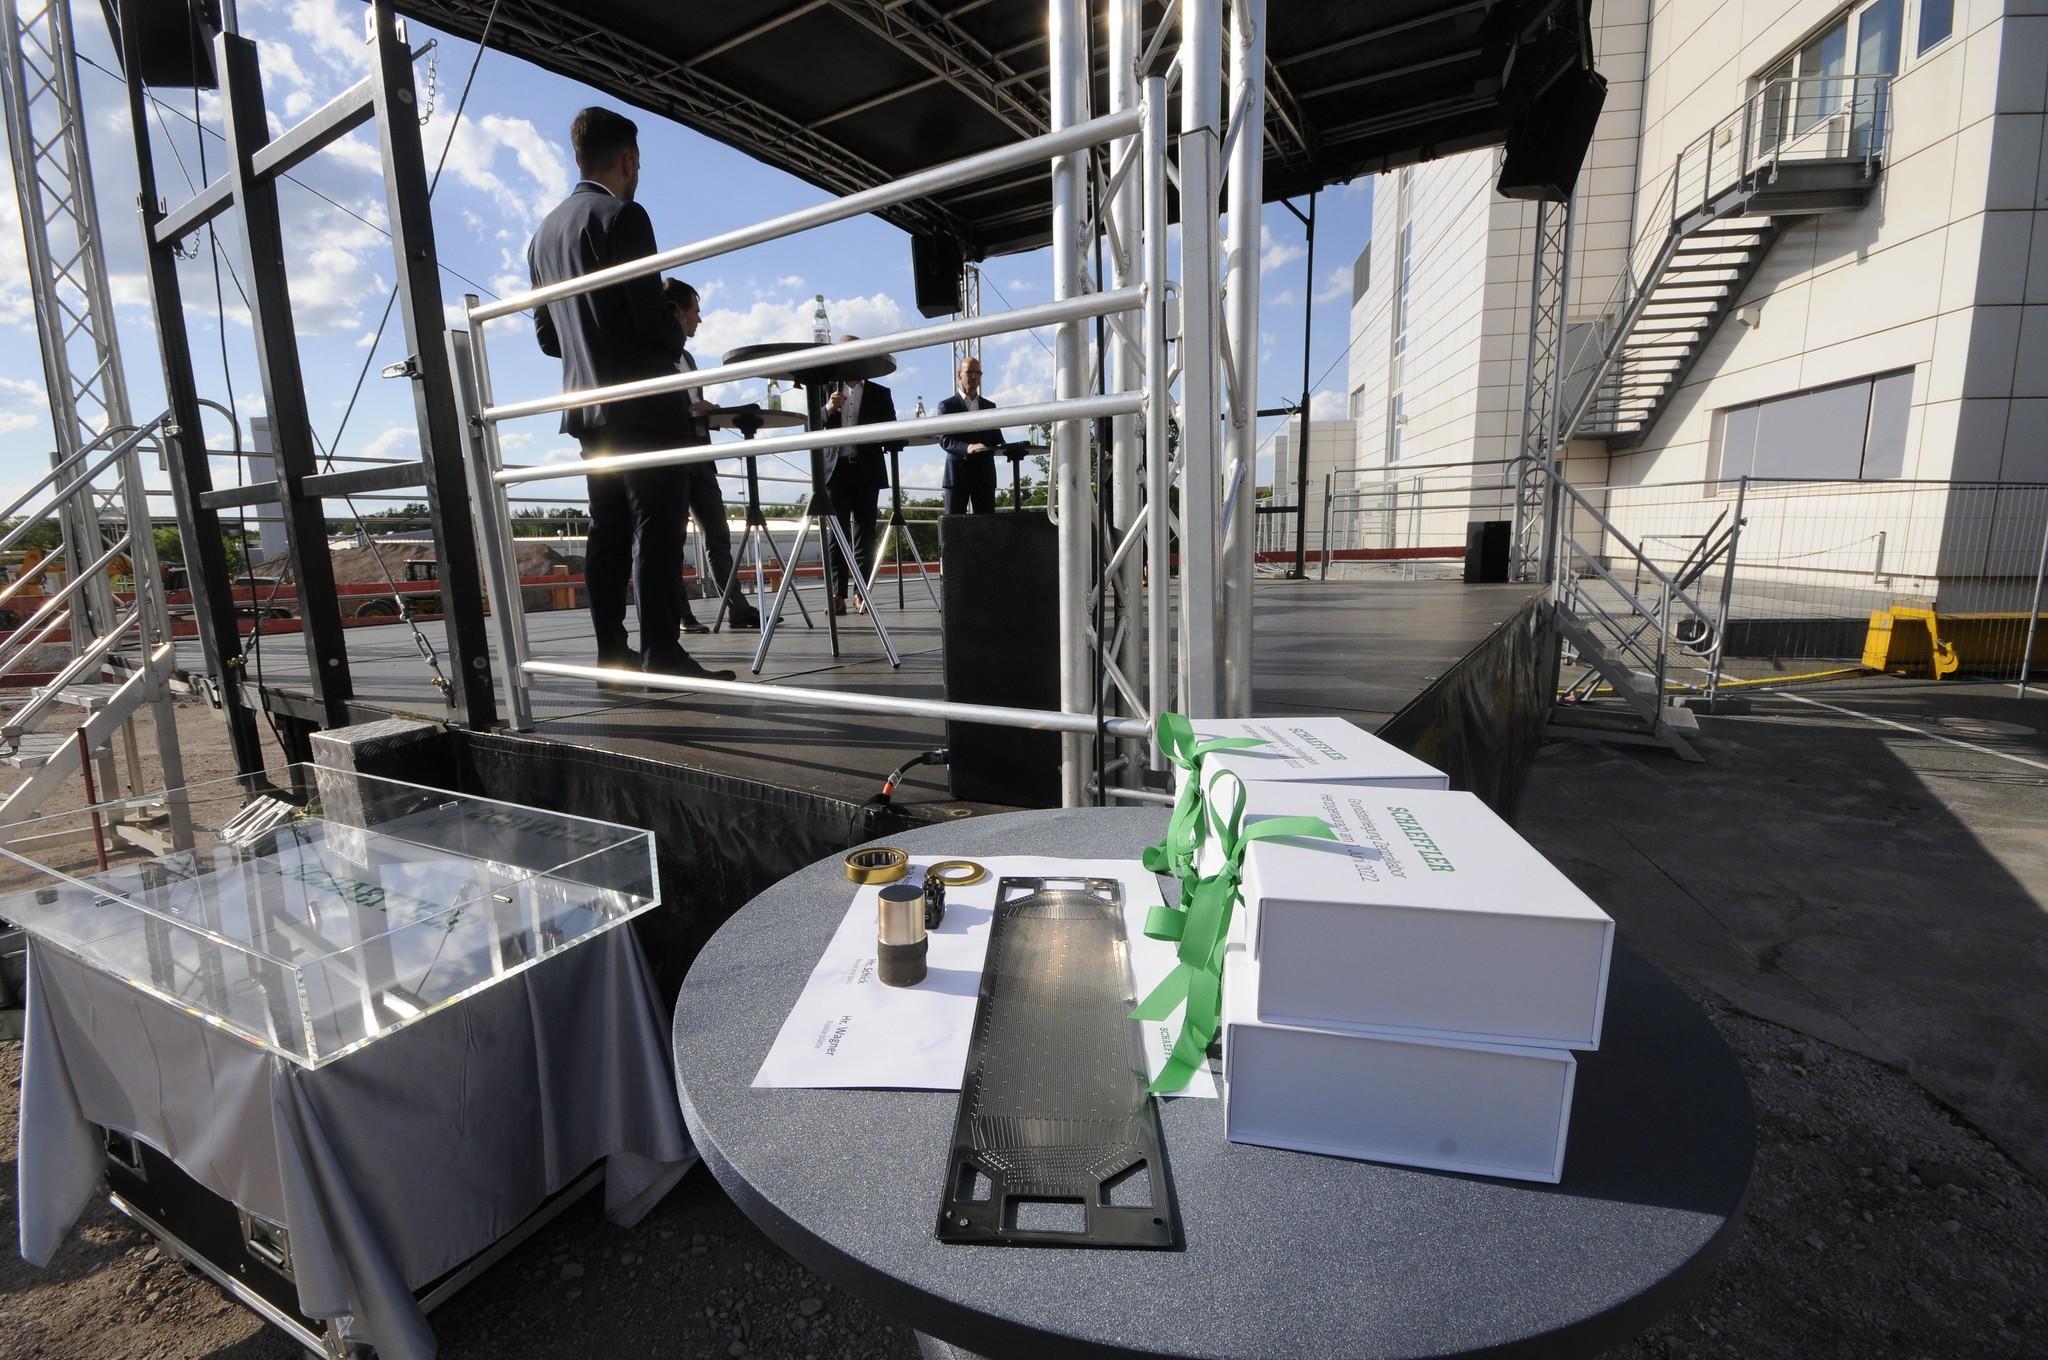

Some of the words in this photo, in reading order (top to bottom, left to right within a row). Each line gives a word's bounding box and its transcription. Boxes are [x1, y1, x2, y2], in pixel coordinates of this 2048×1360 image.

[1386, 806, 1456, 872] SCHAEFFLER
[1354, 862, 1380, 882] 2022
[838, 1015, 852, 1025] Hr.
[826, 1026, 847, 1056] Wagner
[1159, 1027, 1173, 1060] SCHAEFF
